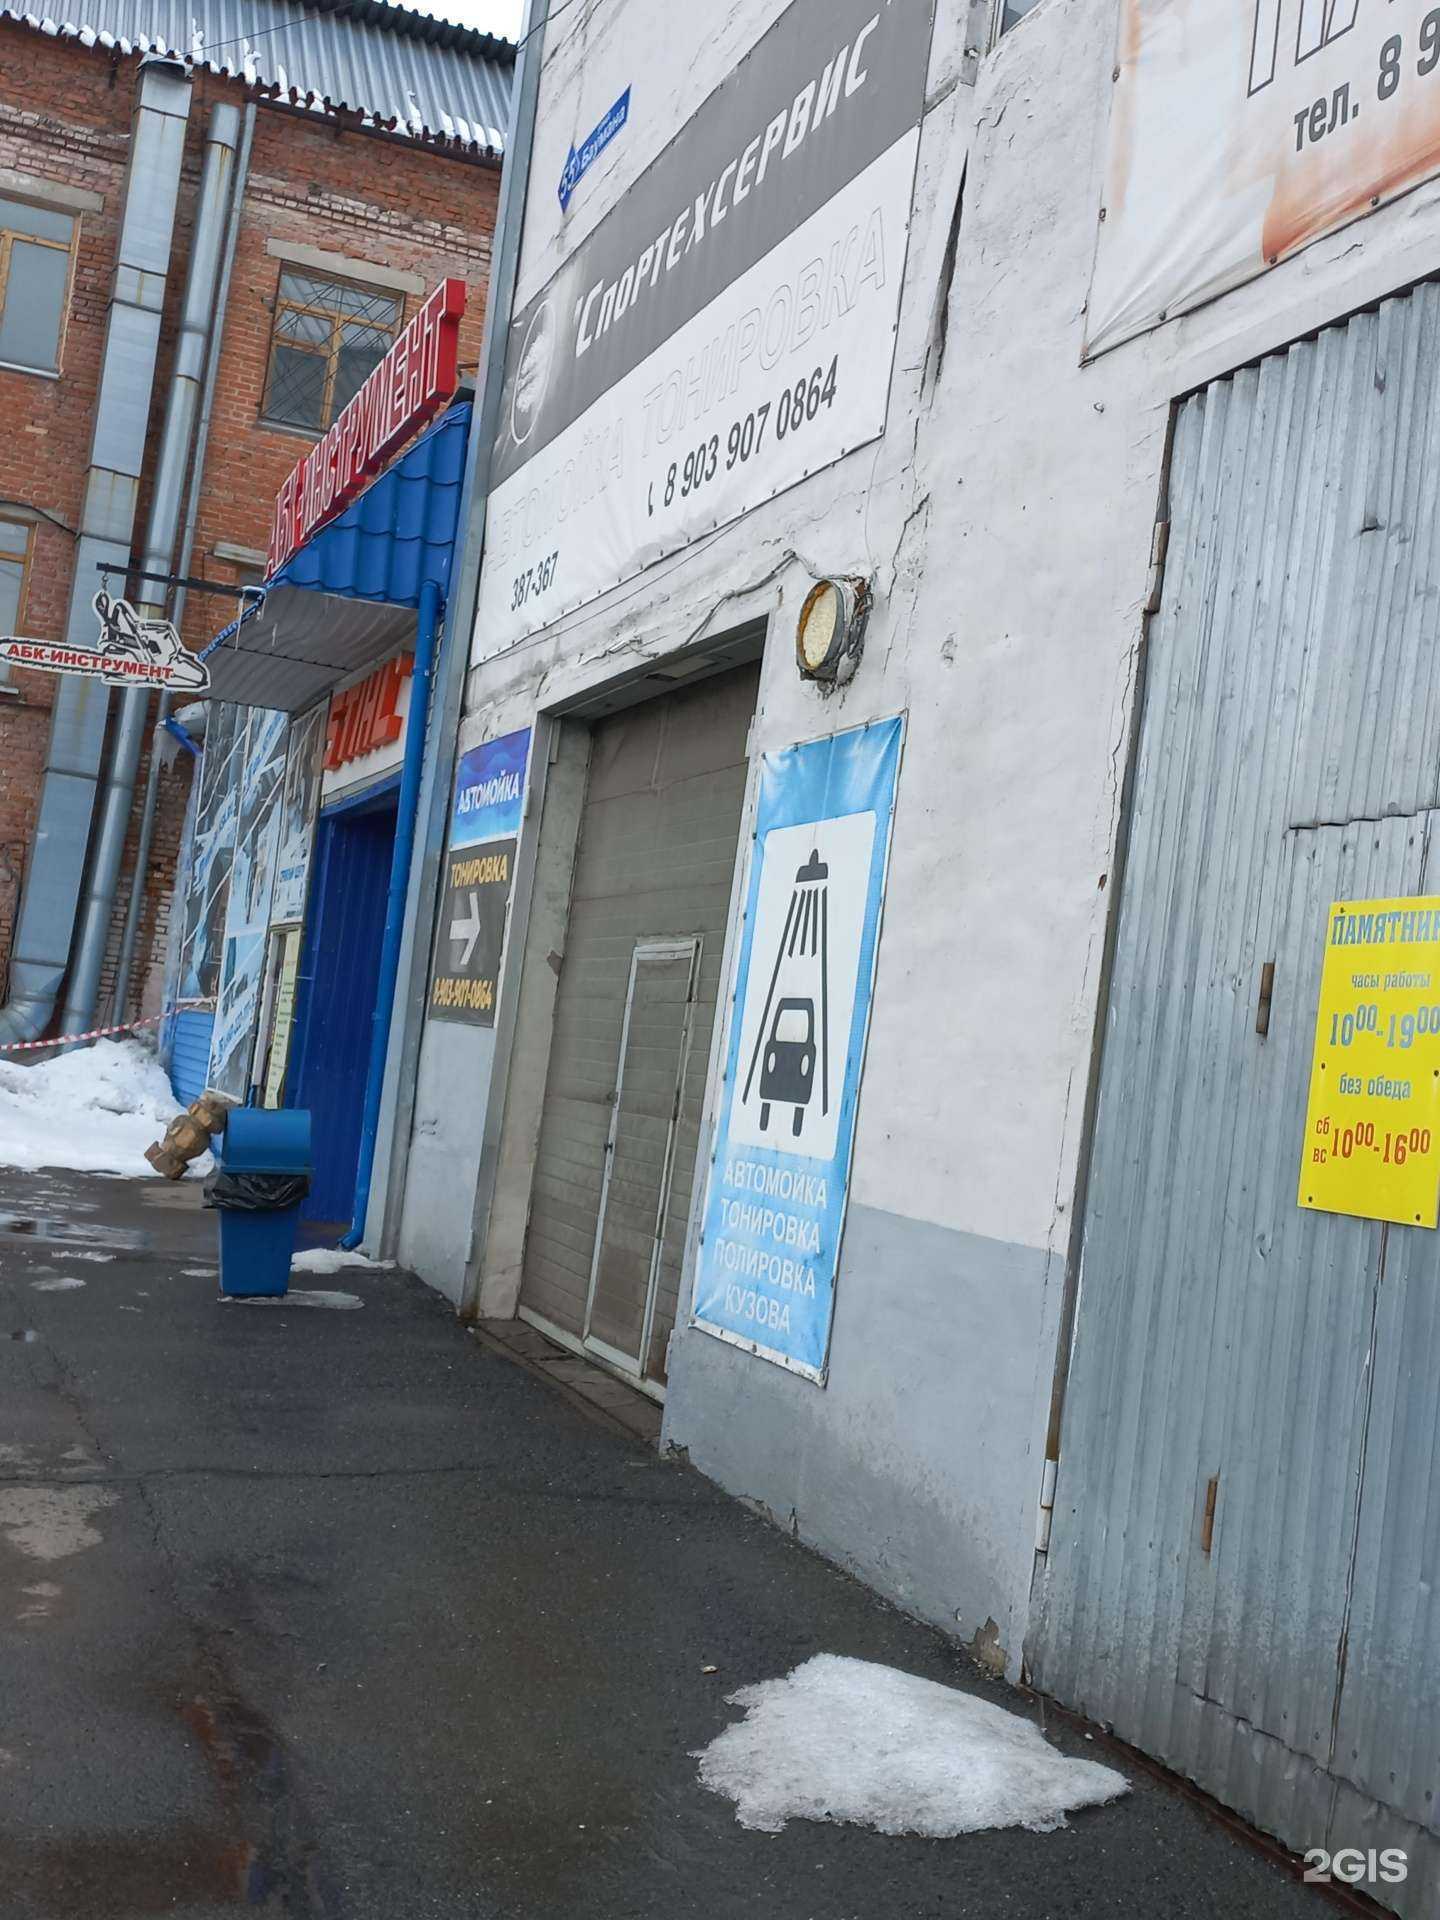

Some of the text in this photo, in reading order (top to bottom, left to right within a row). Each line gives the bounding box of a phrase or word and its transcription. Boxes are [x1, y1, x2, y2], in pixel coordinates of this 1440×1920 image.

[1294, 82, 1359, 152] тел.
[1377, 34, 1402, 101] 8
[642, 206, 886, 459] ТОНИРОВКА
[664, 354, 838, 507] 8 903 907 0864
[511, 551, 559, 612] 387-367
[7, 644, 174, 679] АБК-ИНСТРУМЕНТ
[323, 656, 404, 773] STIHL
[457, 770, 520, 815] АВТОМОЙКА
[450, 854, 508, 889] ТОНИРОВКА
[1352, 970, 1431, 992] часы работы
[1340, 1073, 1411, 1101] без обеда
[1316, 1116, 1330, 1135] сб
[1313, 1147, 1327, 1164] вс
[723, 1159, 828, 1210] АВТОМОЙКА
[720, 1198, 821, 1254] ТОНИРОВКА
[713, 1237, 816, 1299] ПОЛИРОВКА
[725, 1282, 791, 1336] КУЗОВА
